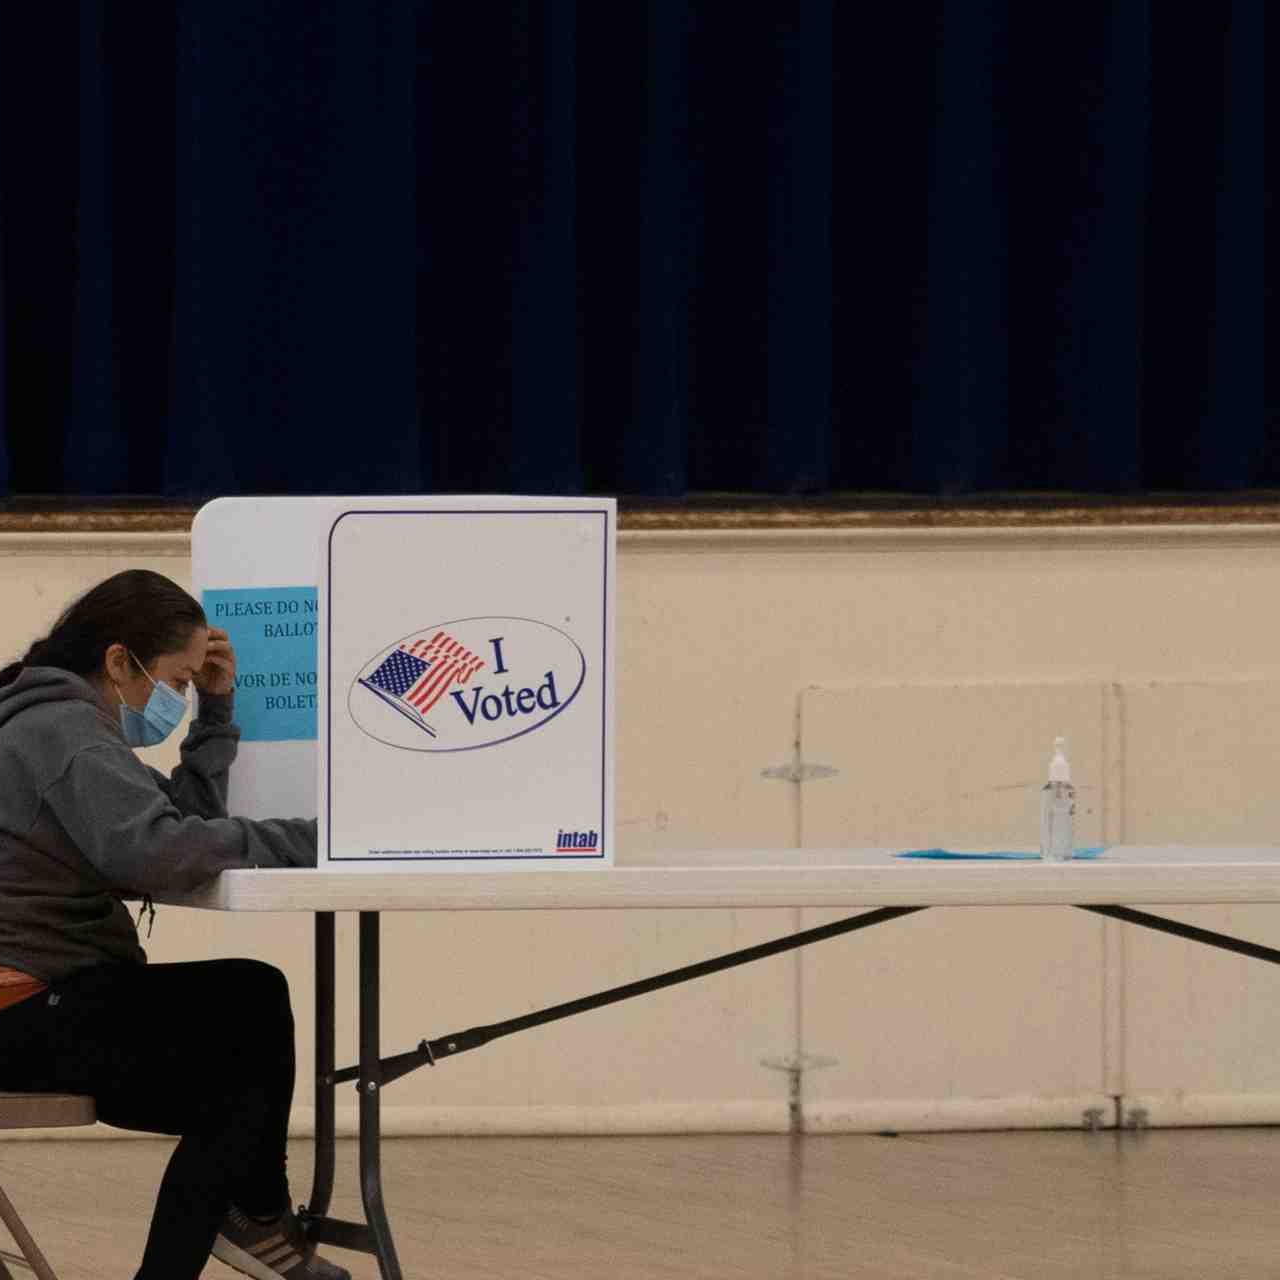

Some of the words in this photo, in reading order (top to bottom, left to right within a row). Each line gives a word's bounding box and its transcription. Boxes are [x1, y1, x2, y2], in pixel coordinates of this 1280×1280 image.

[215, 601, 273, 616] PLEASE
[277, 599, 299, 614] DO
[488, 637, 509, 674] I
[270, 672, 290, 687] DE
[265, 694, 318, 710] BOLET
[449, 670, 560, 725] Voted
[556, 829, 598, 848] intab
